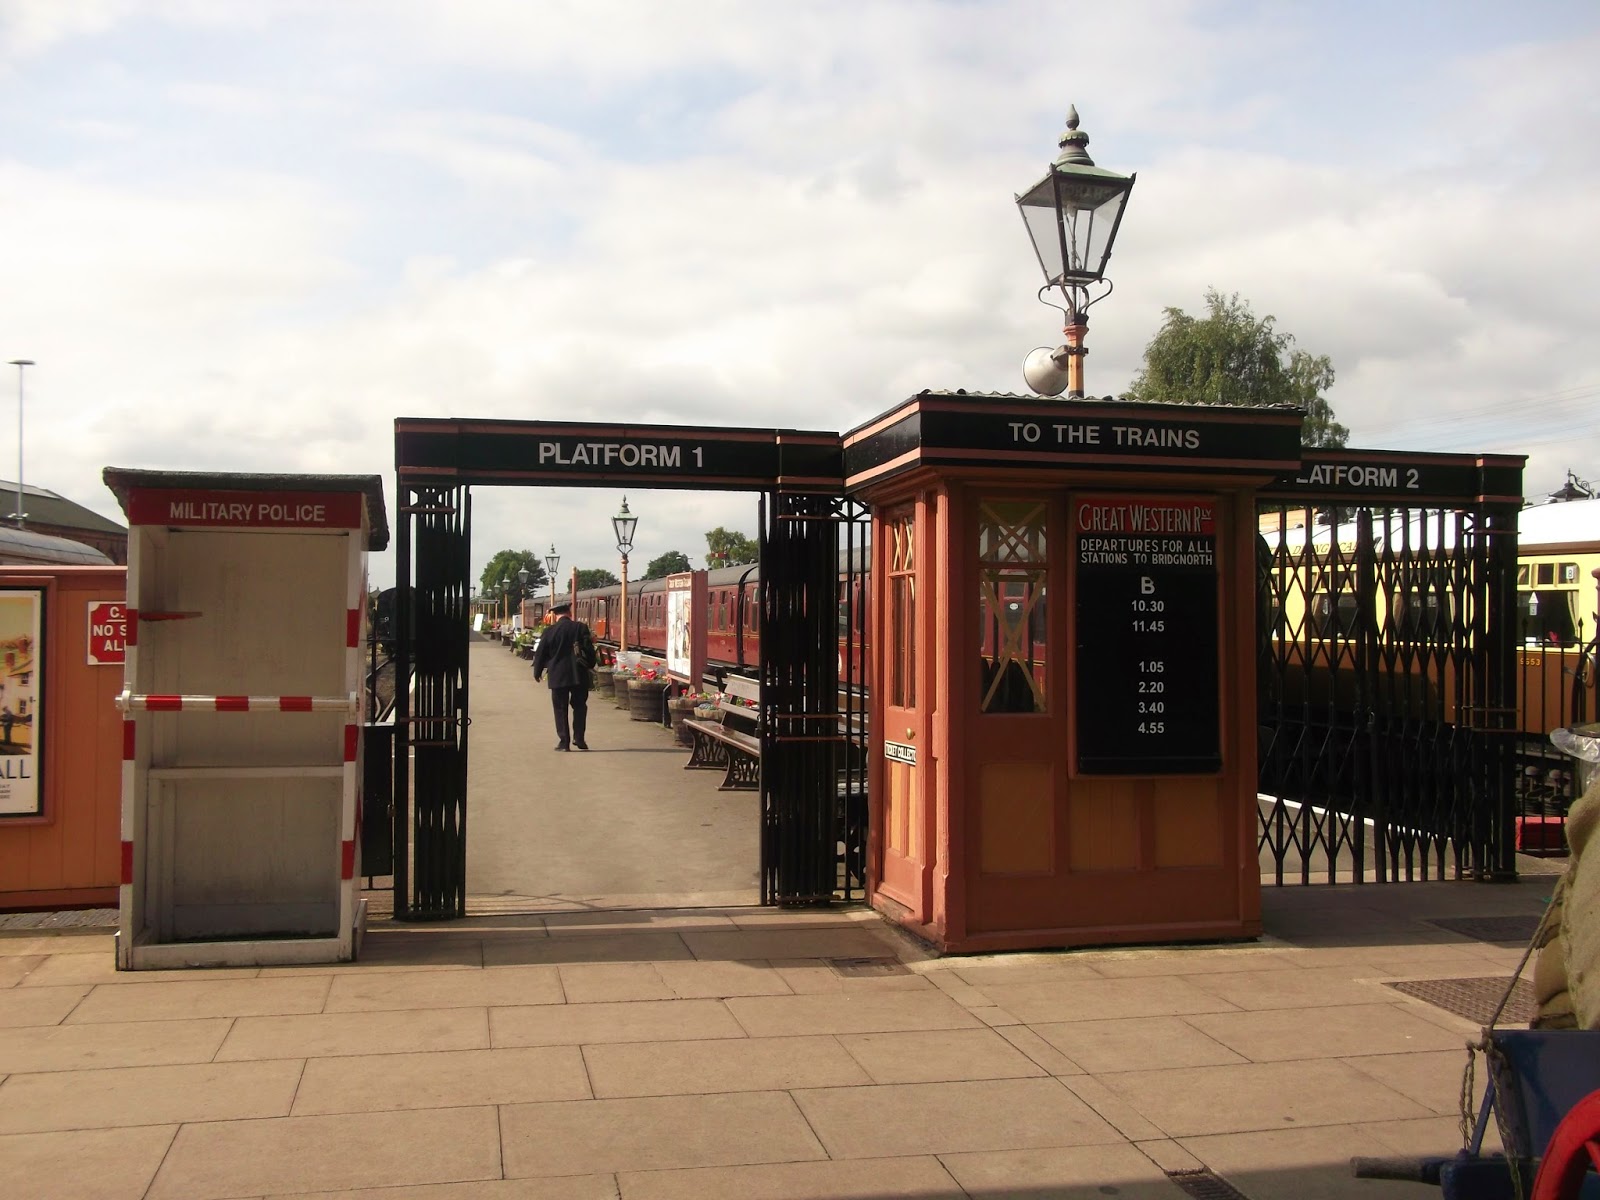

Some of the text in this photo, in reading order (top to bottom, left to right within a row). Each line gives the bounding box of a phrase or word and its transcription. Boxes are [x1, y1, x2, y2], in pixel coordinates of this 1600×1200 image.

[1008, 422, 1200, 449] TO THE TRAINS
[539, 442, 703, 468] PLATFORM 1
[1406, 468, 1419, 489] 2
[170, 501, 326, 522] MILITARY POLICE
[1079, 503, 1126, 531] GREAT
[1129, 504, 1191, 532] WESTERN
[1081, 538, 1213, 553] DEPARTURES FOR ALL
[1081, 552, 1213, 566] STATIONS TO BRIDGNORTH
[1141, 576, 1156, 595] B
[1131, 600, 1165, 612] 10.30
[93, 624, 114, 637] NO
[1132, 620, 1165, 632] 11.45
[1138, 661, 1165, 673] 1.05
[1138, 681, 1165, 693] 2.20
[1138, 702, 1165, 714] 3.40
[1138, 722, 1165, 734] 4.55
